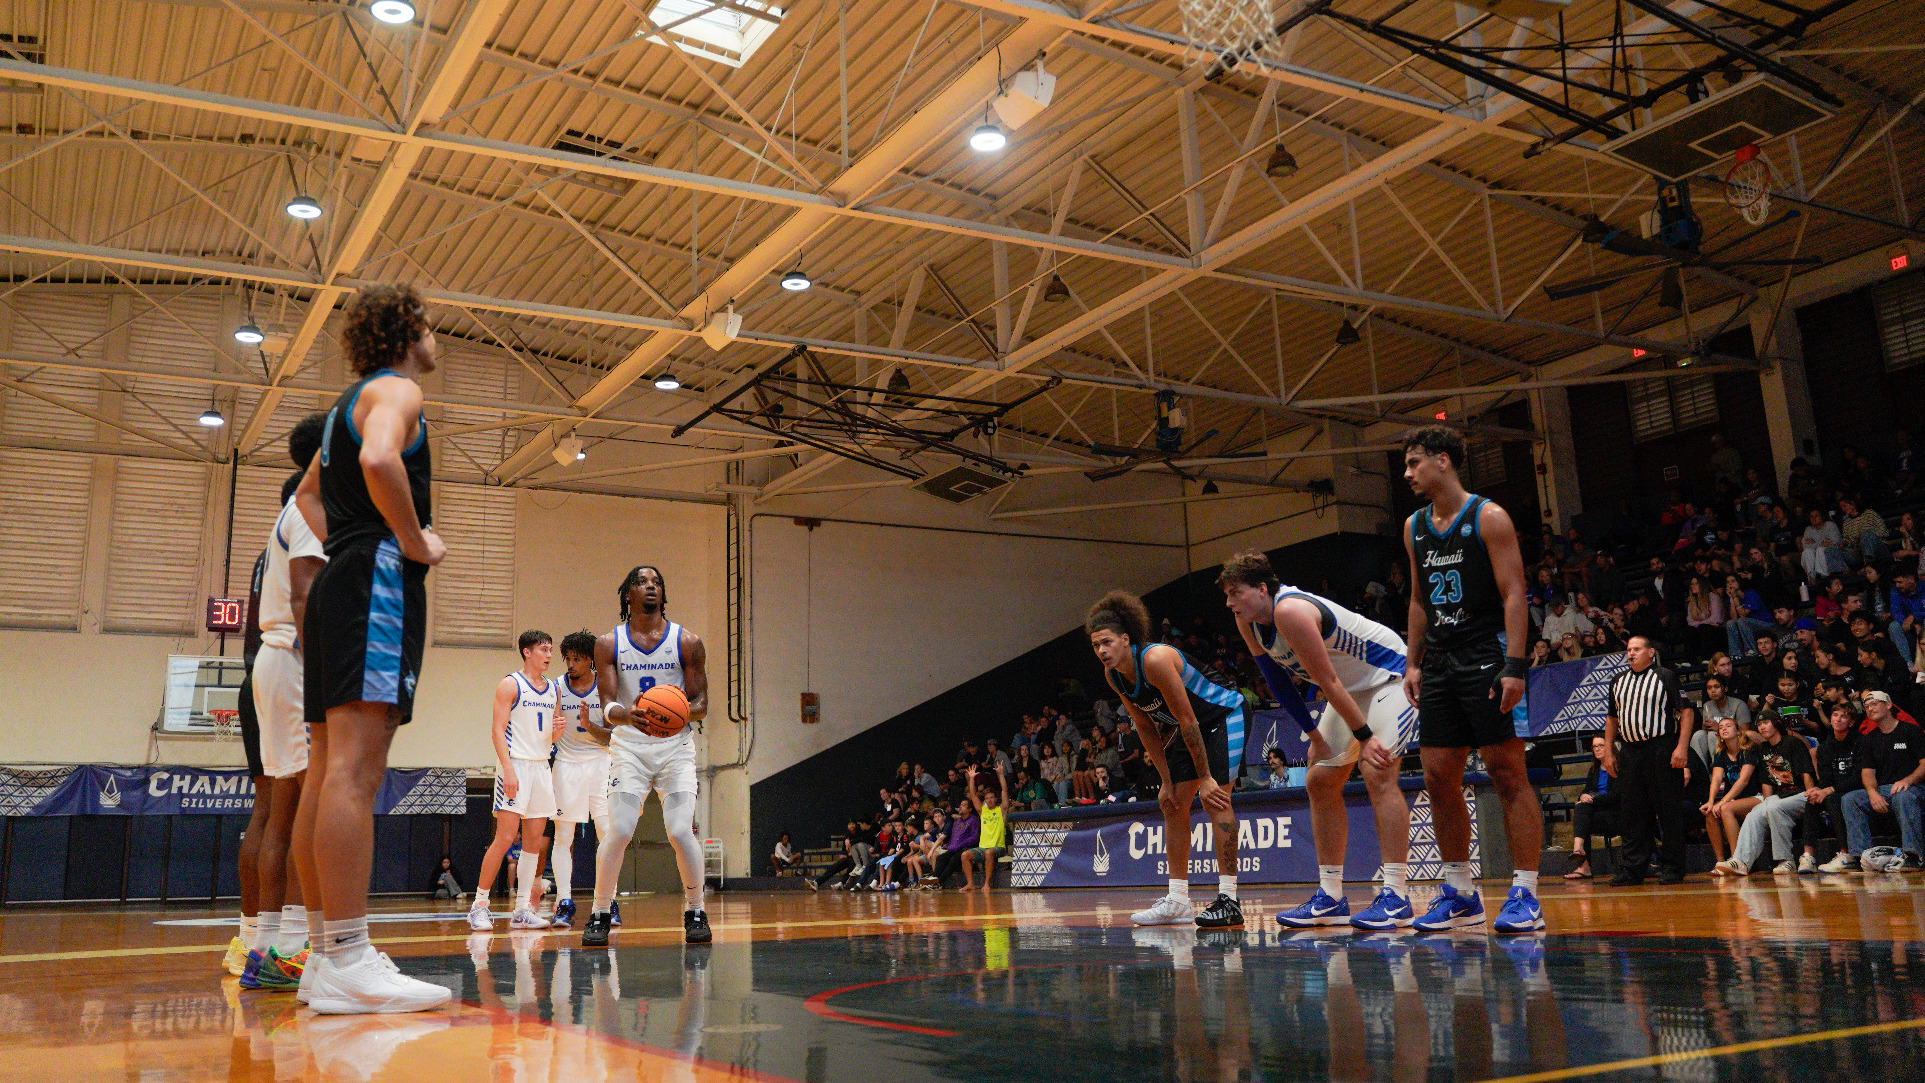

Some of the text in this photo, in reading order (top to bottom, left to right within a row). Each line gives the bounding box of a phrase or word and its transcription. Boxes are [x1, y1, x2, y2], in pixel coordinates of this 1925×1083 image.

[1891, 255, 1907, 270] EXIT
[1422, 549, 1463, 567] Hawaii
[1429, 569, 1462, 604] 23
[212, 602, 239, 624] 30
[621, 663, 675, 671] CHAMINADE
[537, 712, 542, 731] 1
[148, 771, 256, 797] CHAMI
[181, 798, 254, 808] SILVERSW
